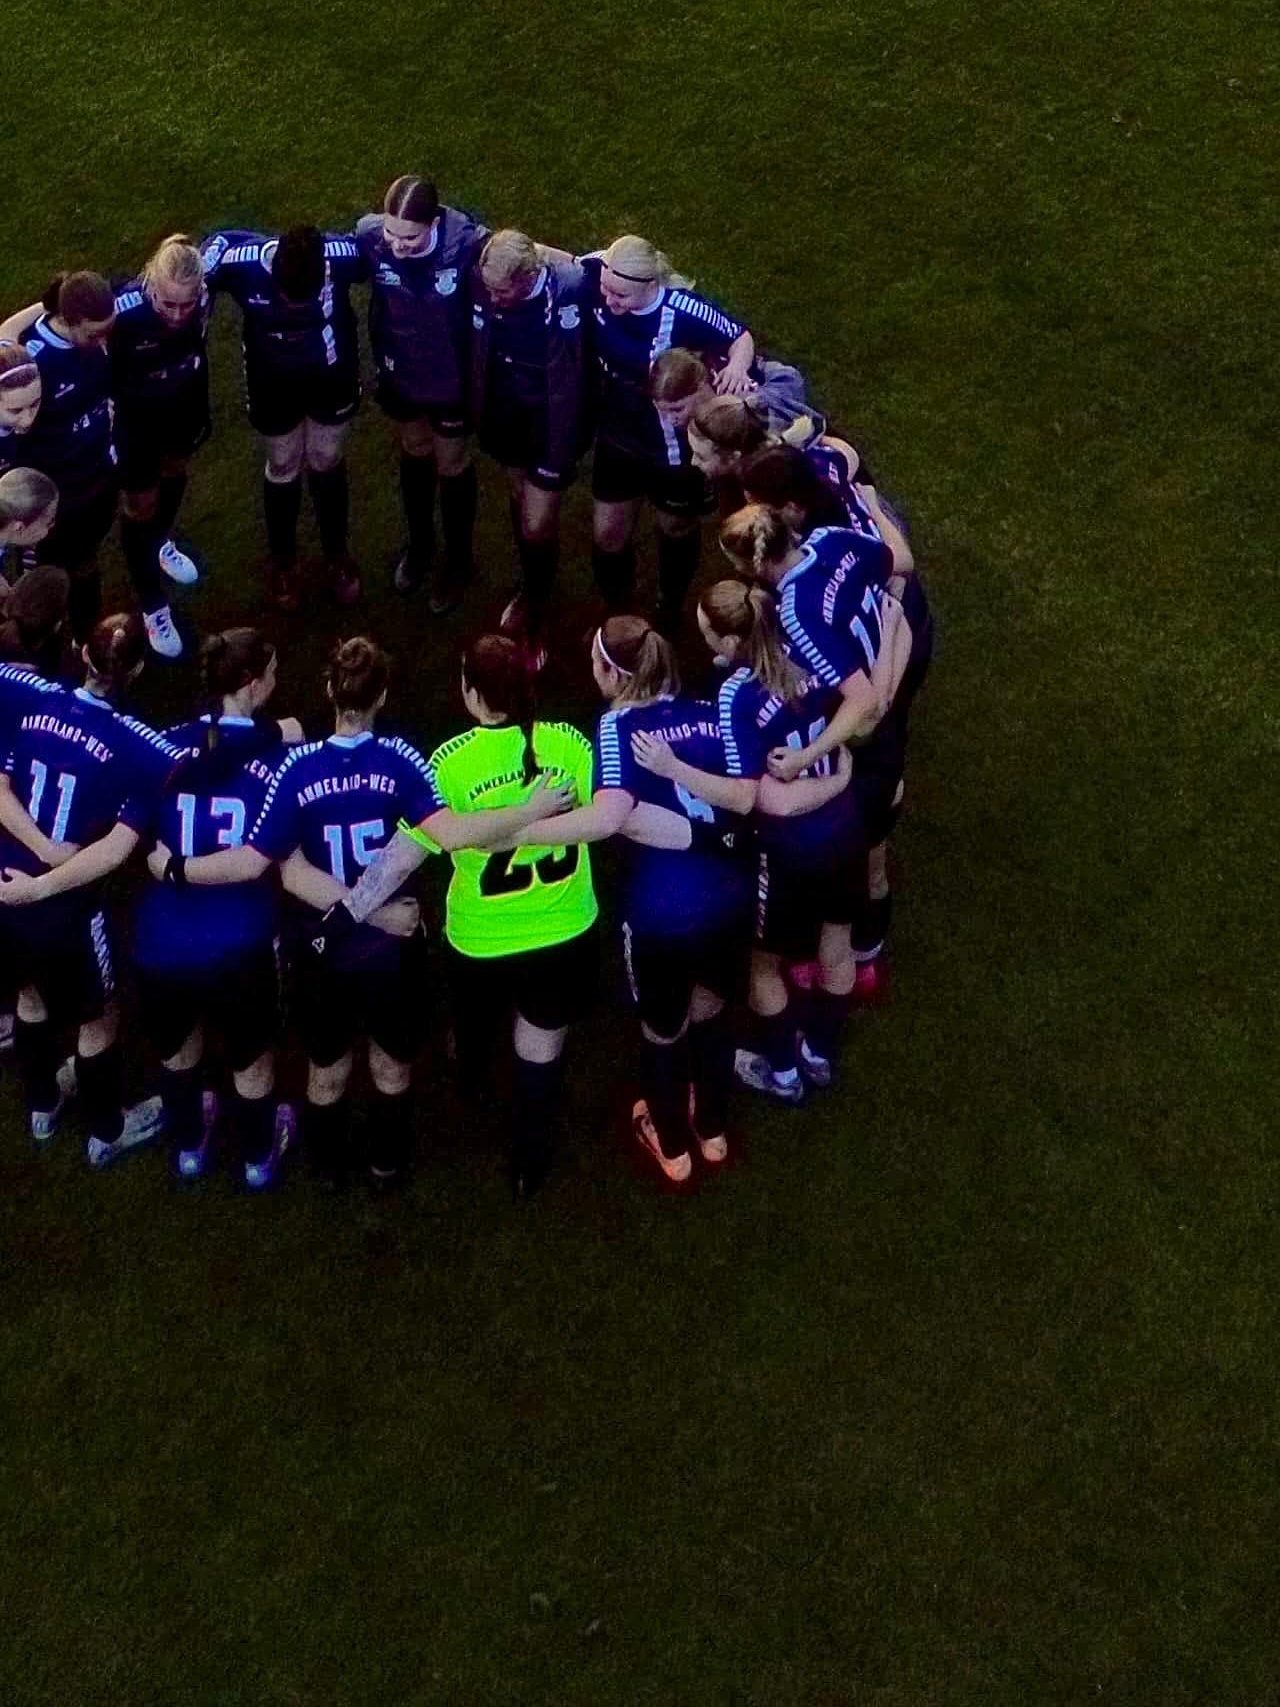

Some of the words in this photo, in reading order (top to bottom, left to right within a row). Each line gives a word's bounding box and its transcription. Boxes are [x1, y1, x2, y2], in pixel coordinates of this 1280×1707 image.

[29, 758, 77, 844] 11
[176, 792, 246, 858] 13
[323, 818, 385, 885] 15
